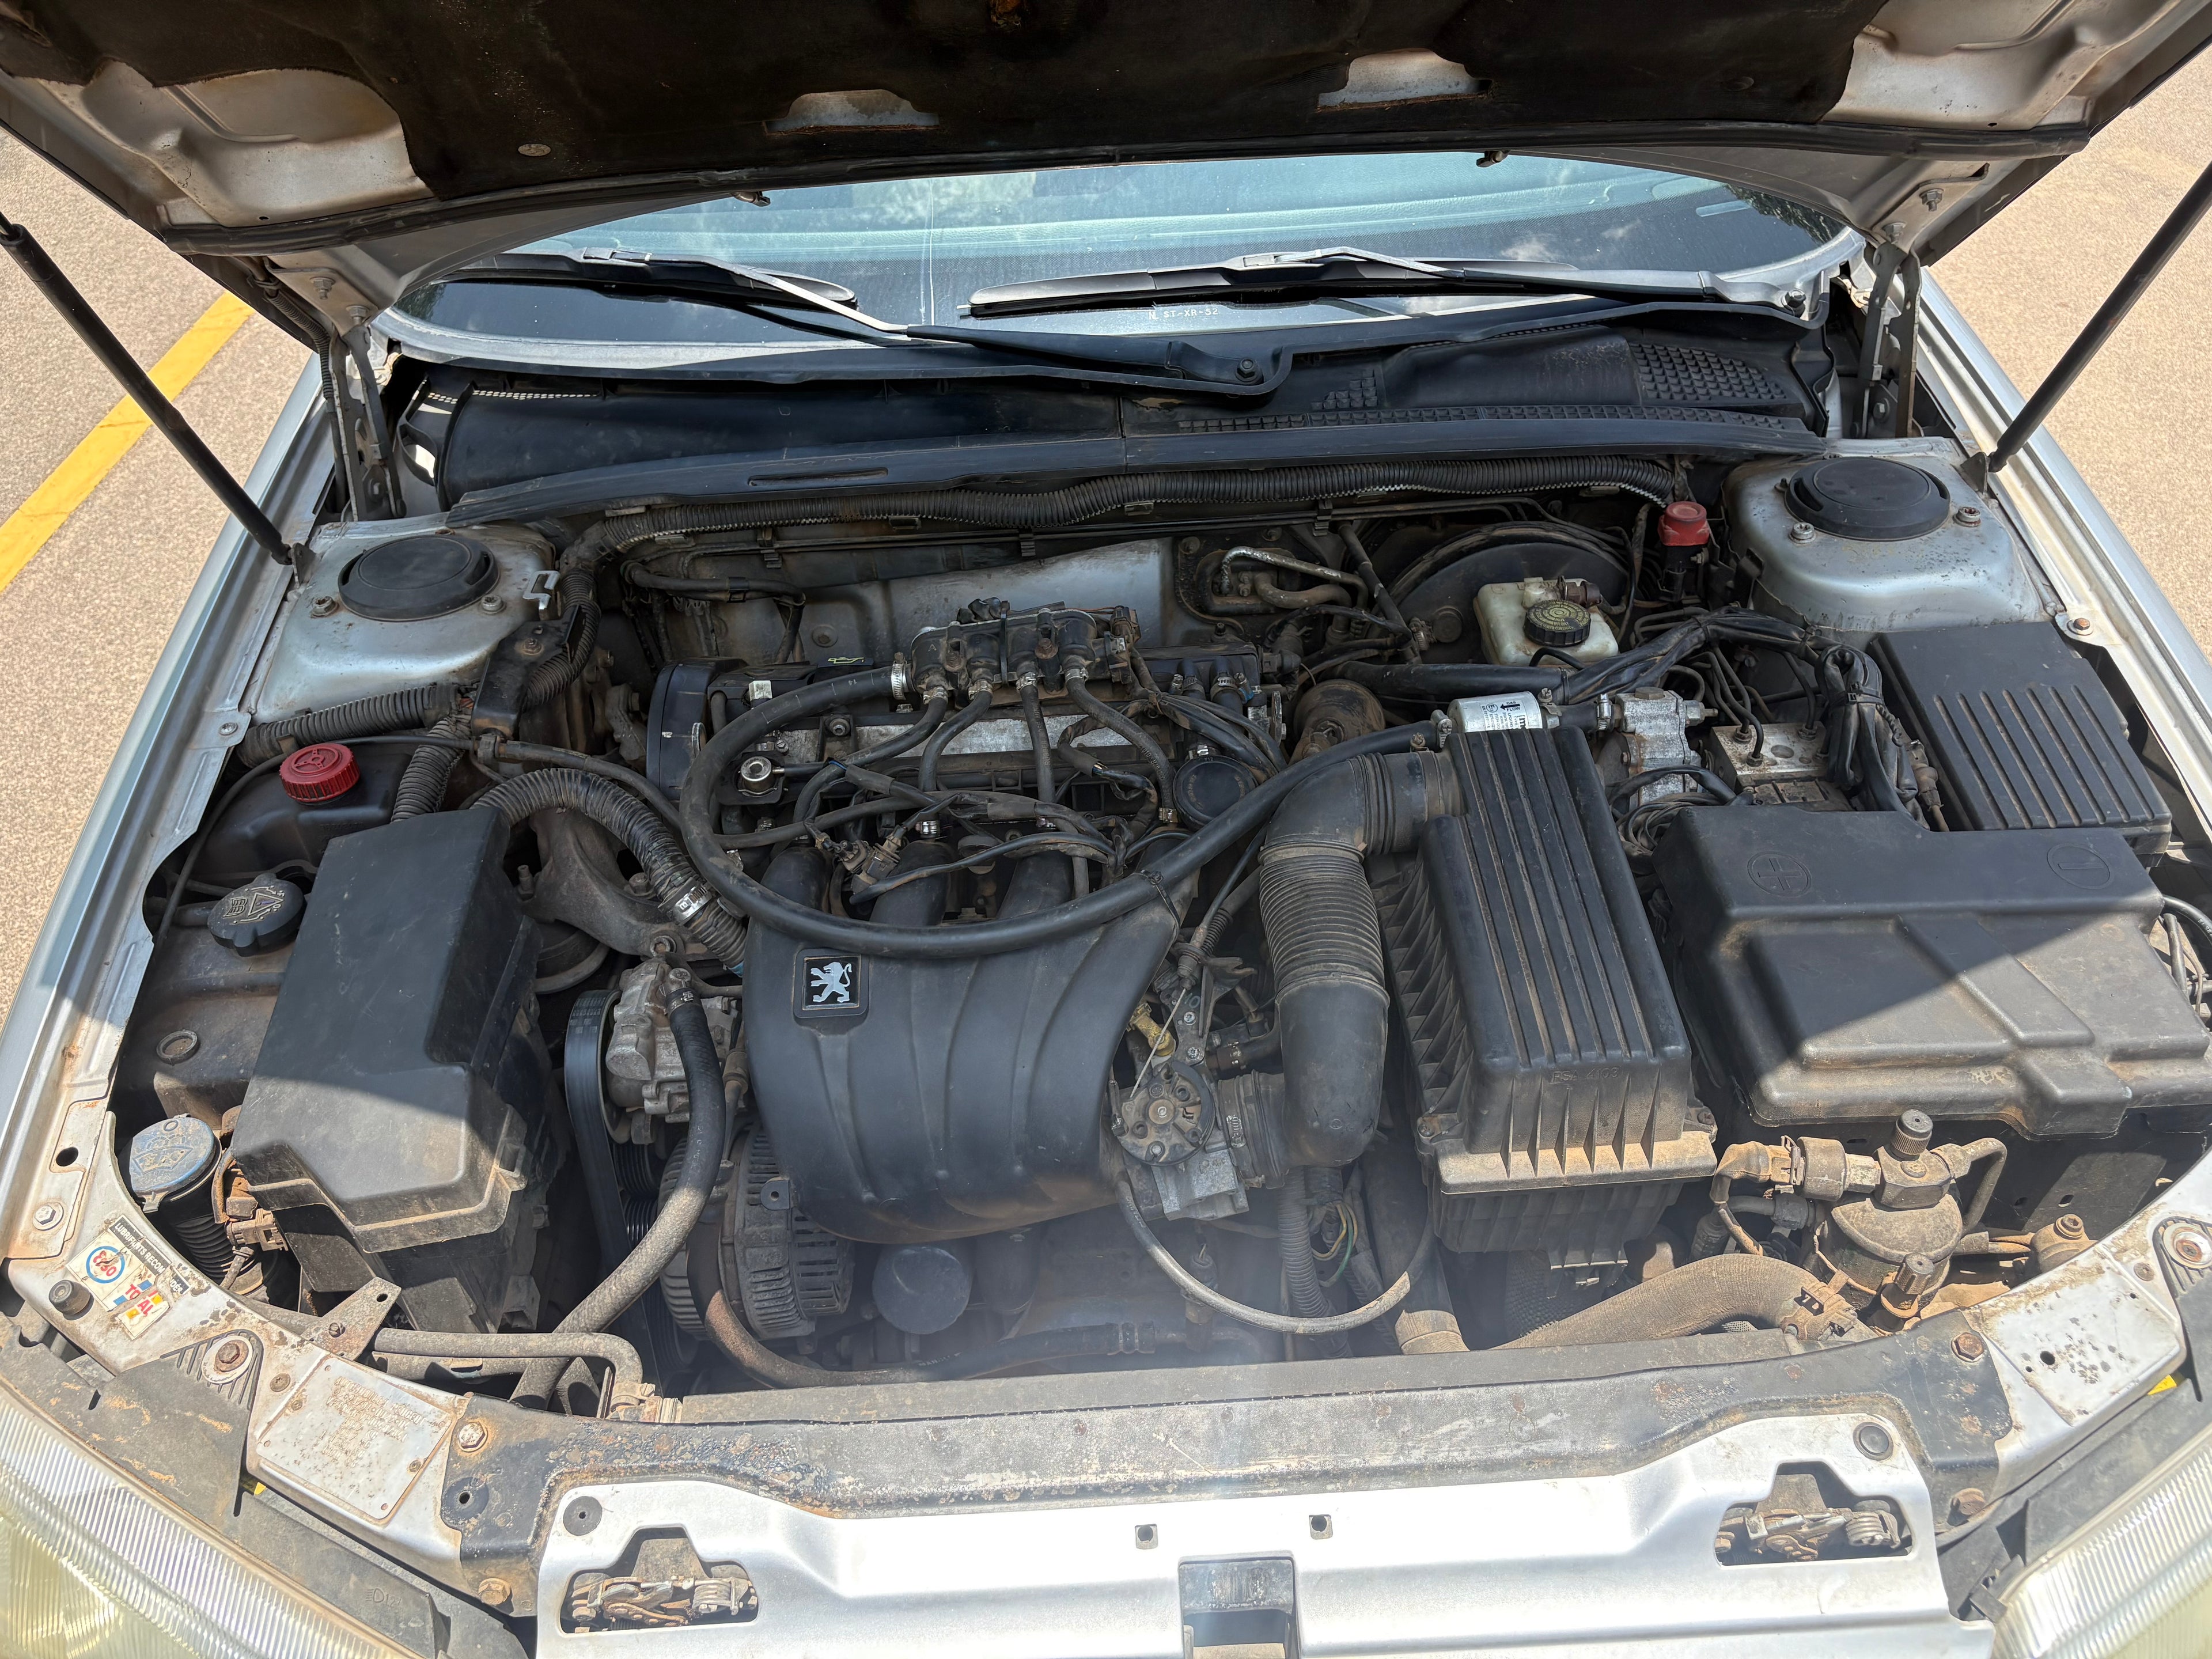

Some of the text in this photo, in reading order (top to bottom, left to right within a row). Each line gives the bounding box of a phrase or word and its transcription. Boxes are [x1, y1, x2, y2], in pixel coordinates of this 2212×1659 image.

[1164, 308, 1218, 318] ST-XR-52
[125, 1283, 154, 1316] TOAL
[334, 1376, 427, 1425] AUTOMOBILES PEUGEOT
